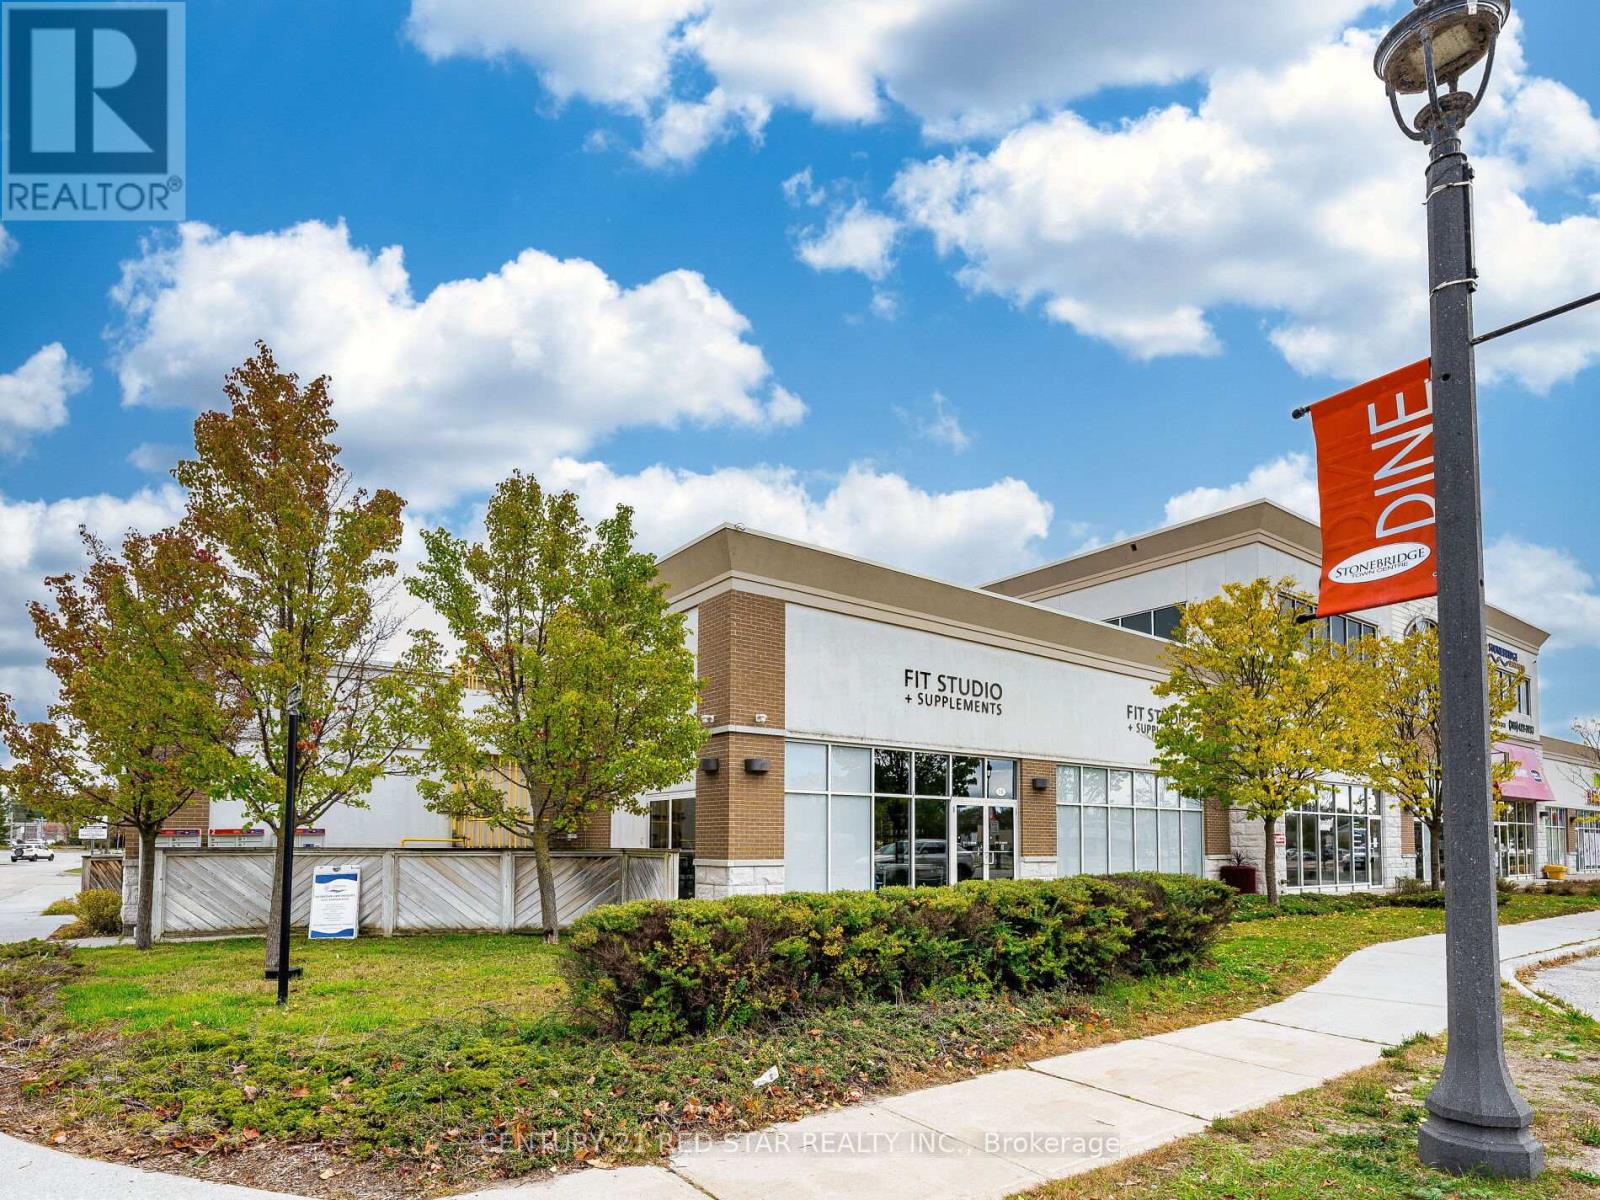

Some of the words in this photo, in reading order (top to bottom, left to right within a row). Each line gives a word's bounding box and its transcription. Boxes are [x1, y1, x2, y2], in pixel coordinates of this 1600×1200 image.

[1367, 379, 1436, 539] DINE
[1335, 547, 1425, 579] STONEBRIDGE
[1351, 570, 1375, 579] TOWN
[904, 668, 931, 690] FIT
[937, 674, 1003, 701] STUDIO
[917, 692, 1003, 716] SUPPLEMENTS
[1126, 704, 1145, 722] FIT
